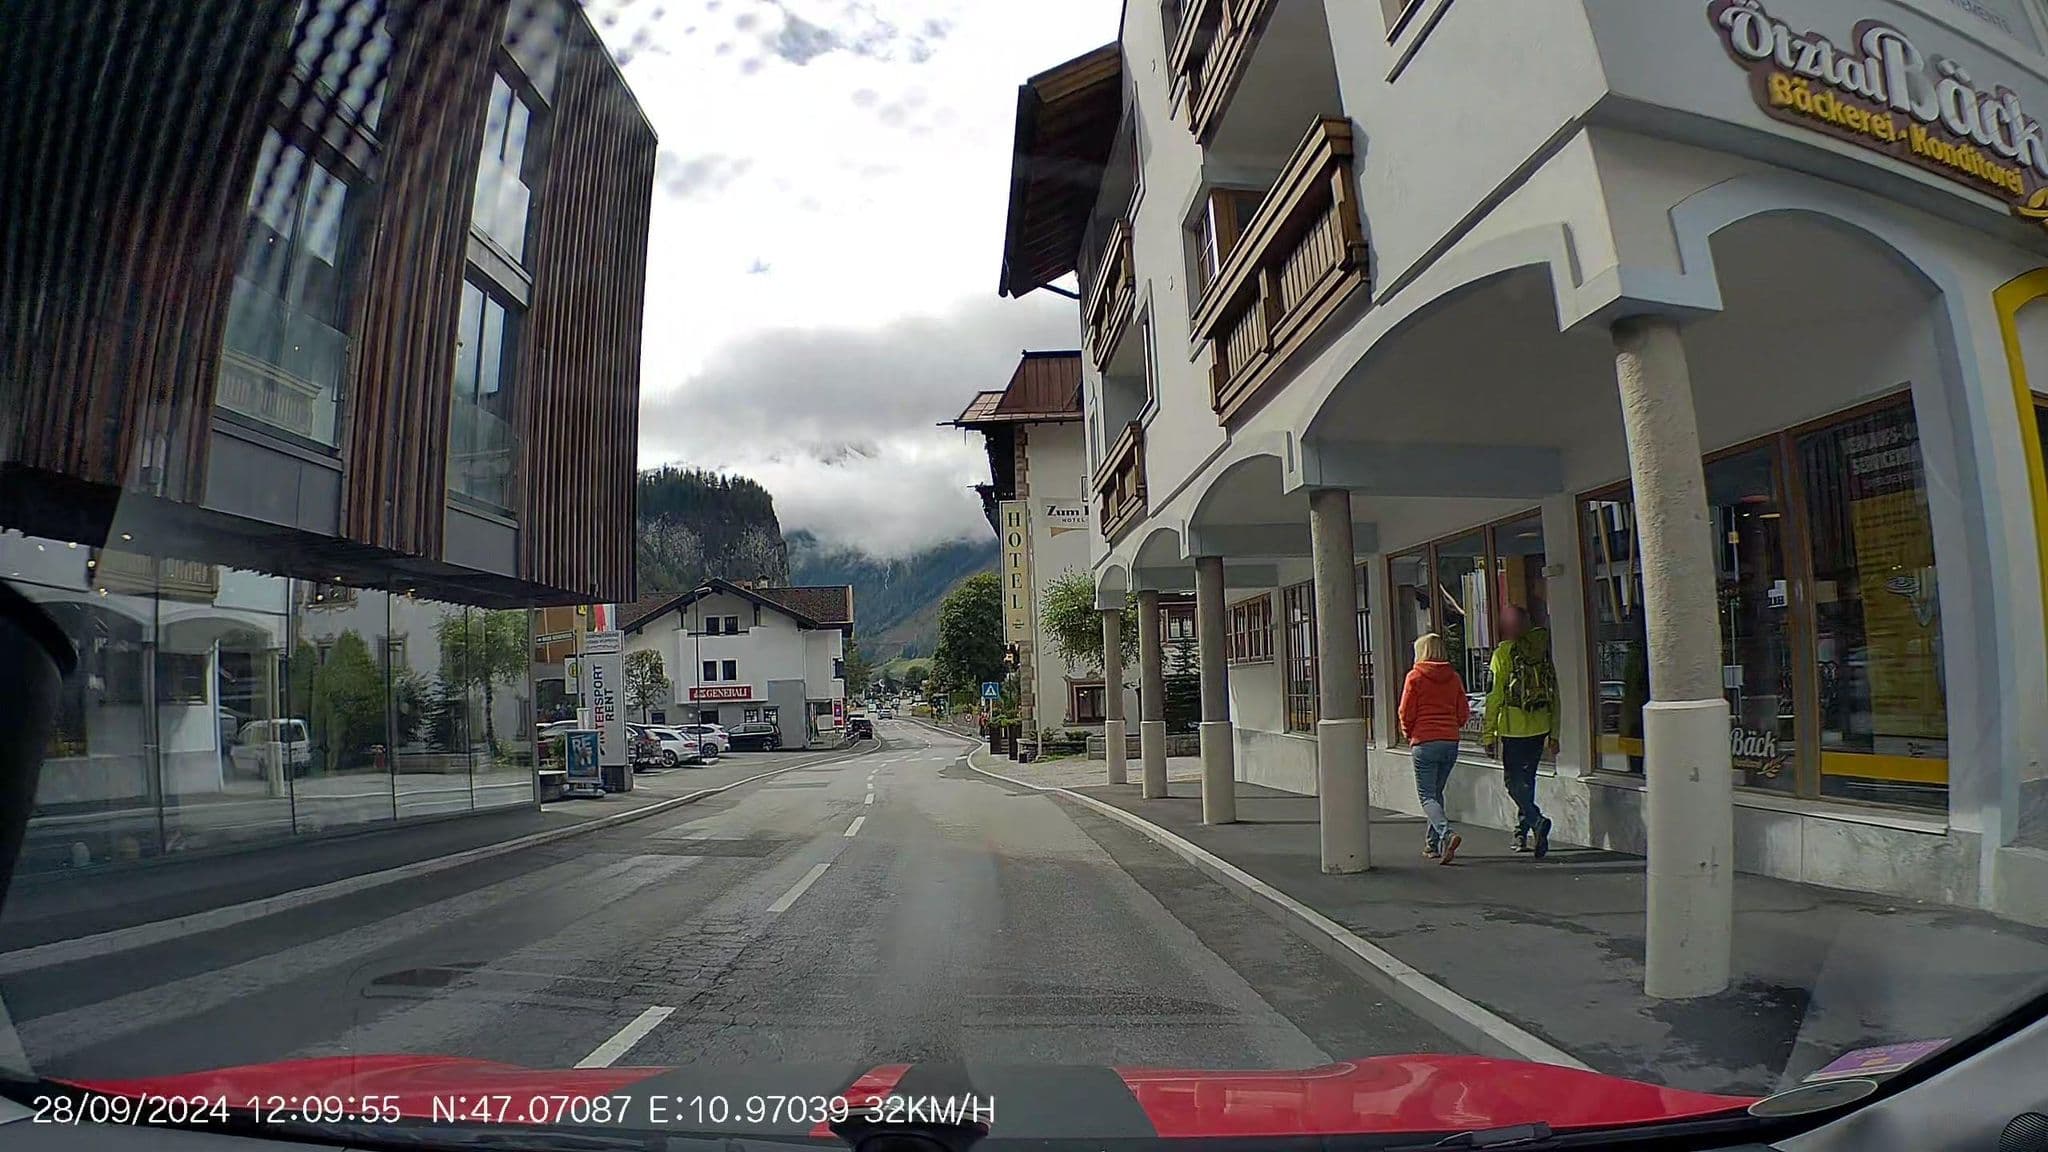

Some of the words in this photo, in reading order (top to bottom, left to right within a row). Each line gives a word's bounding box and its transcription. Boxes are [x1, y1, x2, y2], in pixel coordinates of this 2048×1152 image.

[1046, 505, 1080, 516] Zum
[1008, 511, 1023, 610] HOTEL
[604, 688, 615, 722] RENT
[1729, 727, 1776, 757] Bäck
